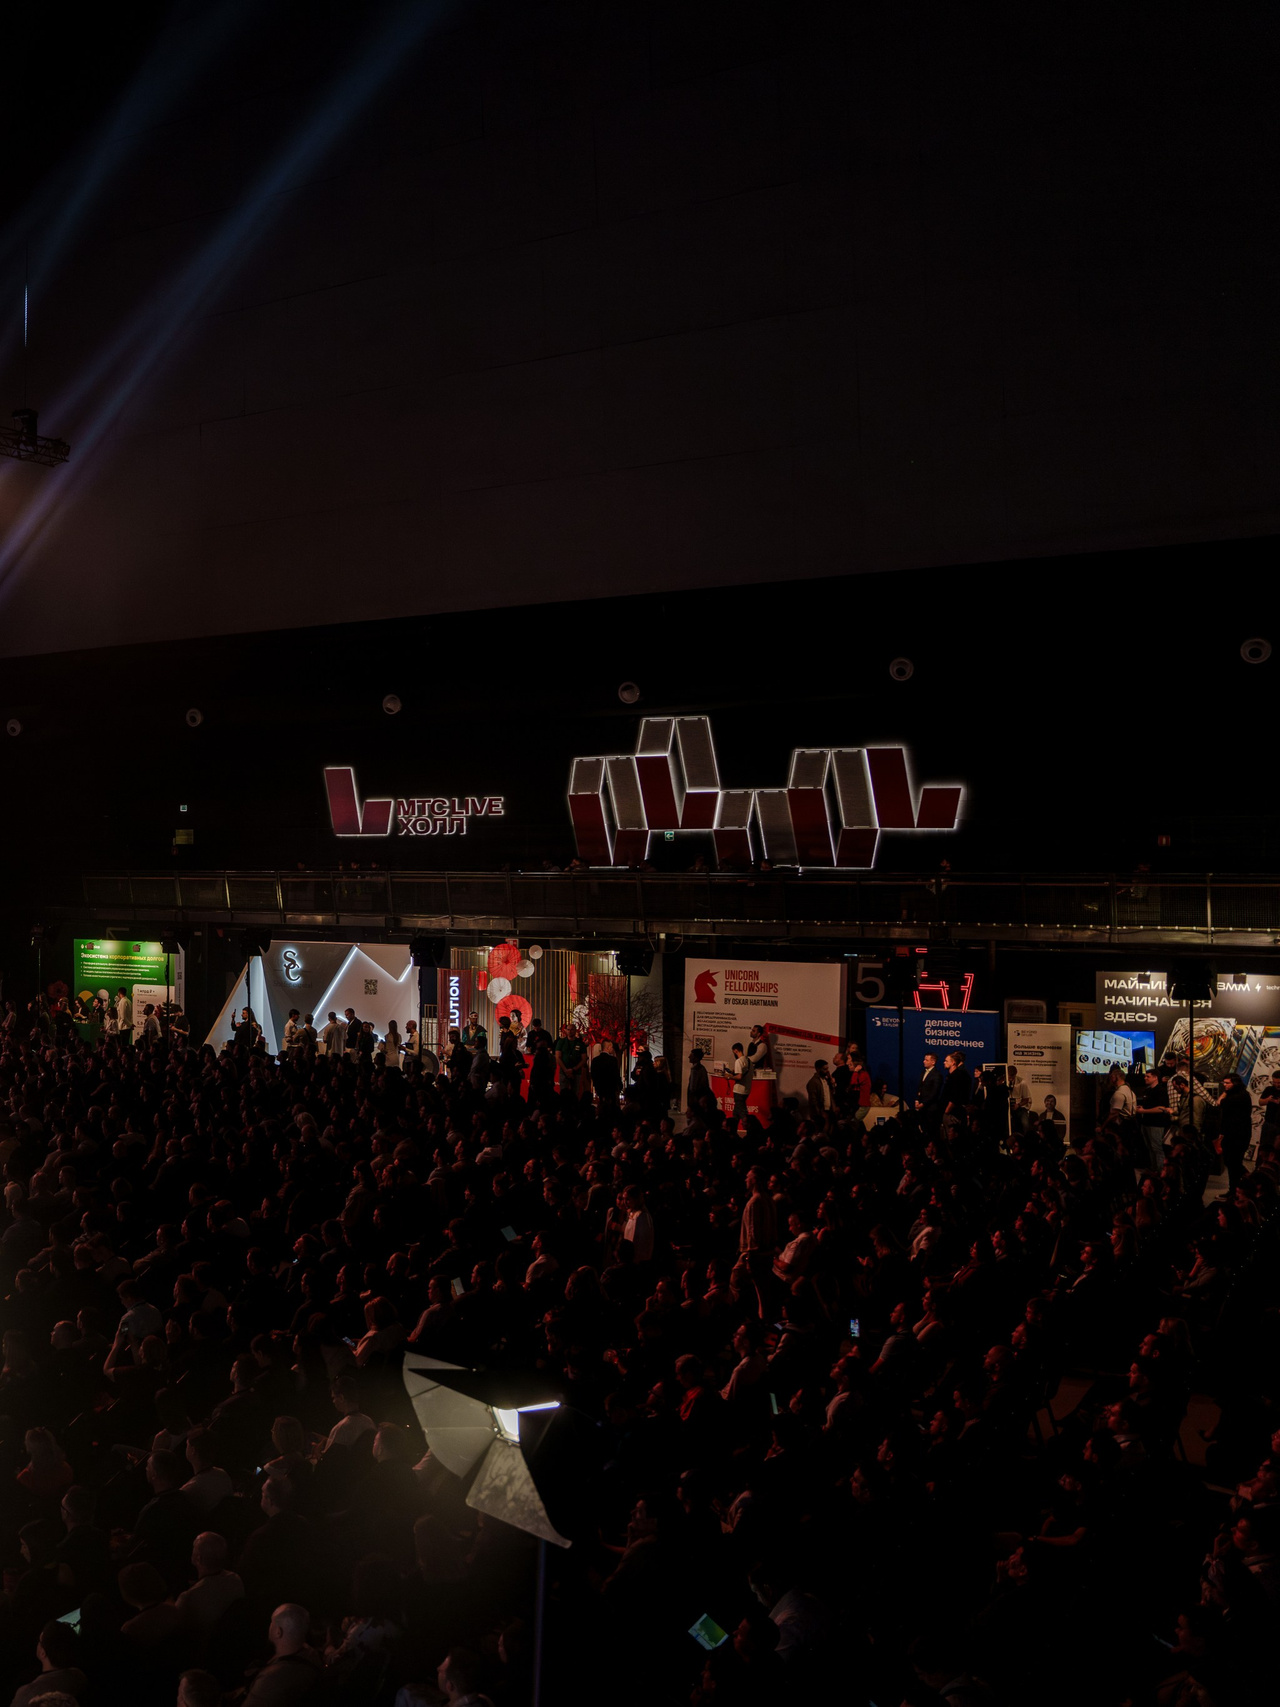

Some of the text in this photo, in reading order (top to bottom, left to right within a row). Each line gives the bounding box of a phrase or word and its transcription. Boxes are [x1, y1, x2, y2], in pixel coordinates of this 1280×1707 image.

[397, 797, 504, 817] МТС LIVE
[398, 817, 467, 835] ХОЛЛ
[724, 969, 759, 981] UNICORN
[724, 981, 778, 994] FELLOWSHIPS
[855, 962, 885, 1003] 5
[724, 997, 778, 1007] BY OSKAR HARTMANN
[924, 1018, 962, 1028] делаем
[1104, 1011, 1158, 1023] ЗДЕСЬ
[924, 1028, 960, 1038] бизнес
[924, 1037, 984, 1048] человечнее
